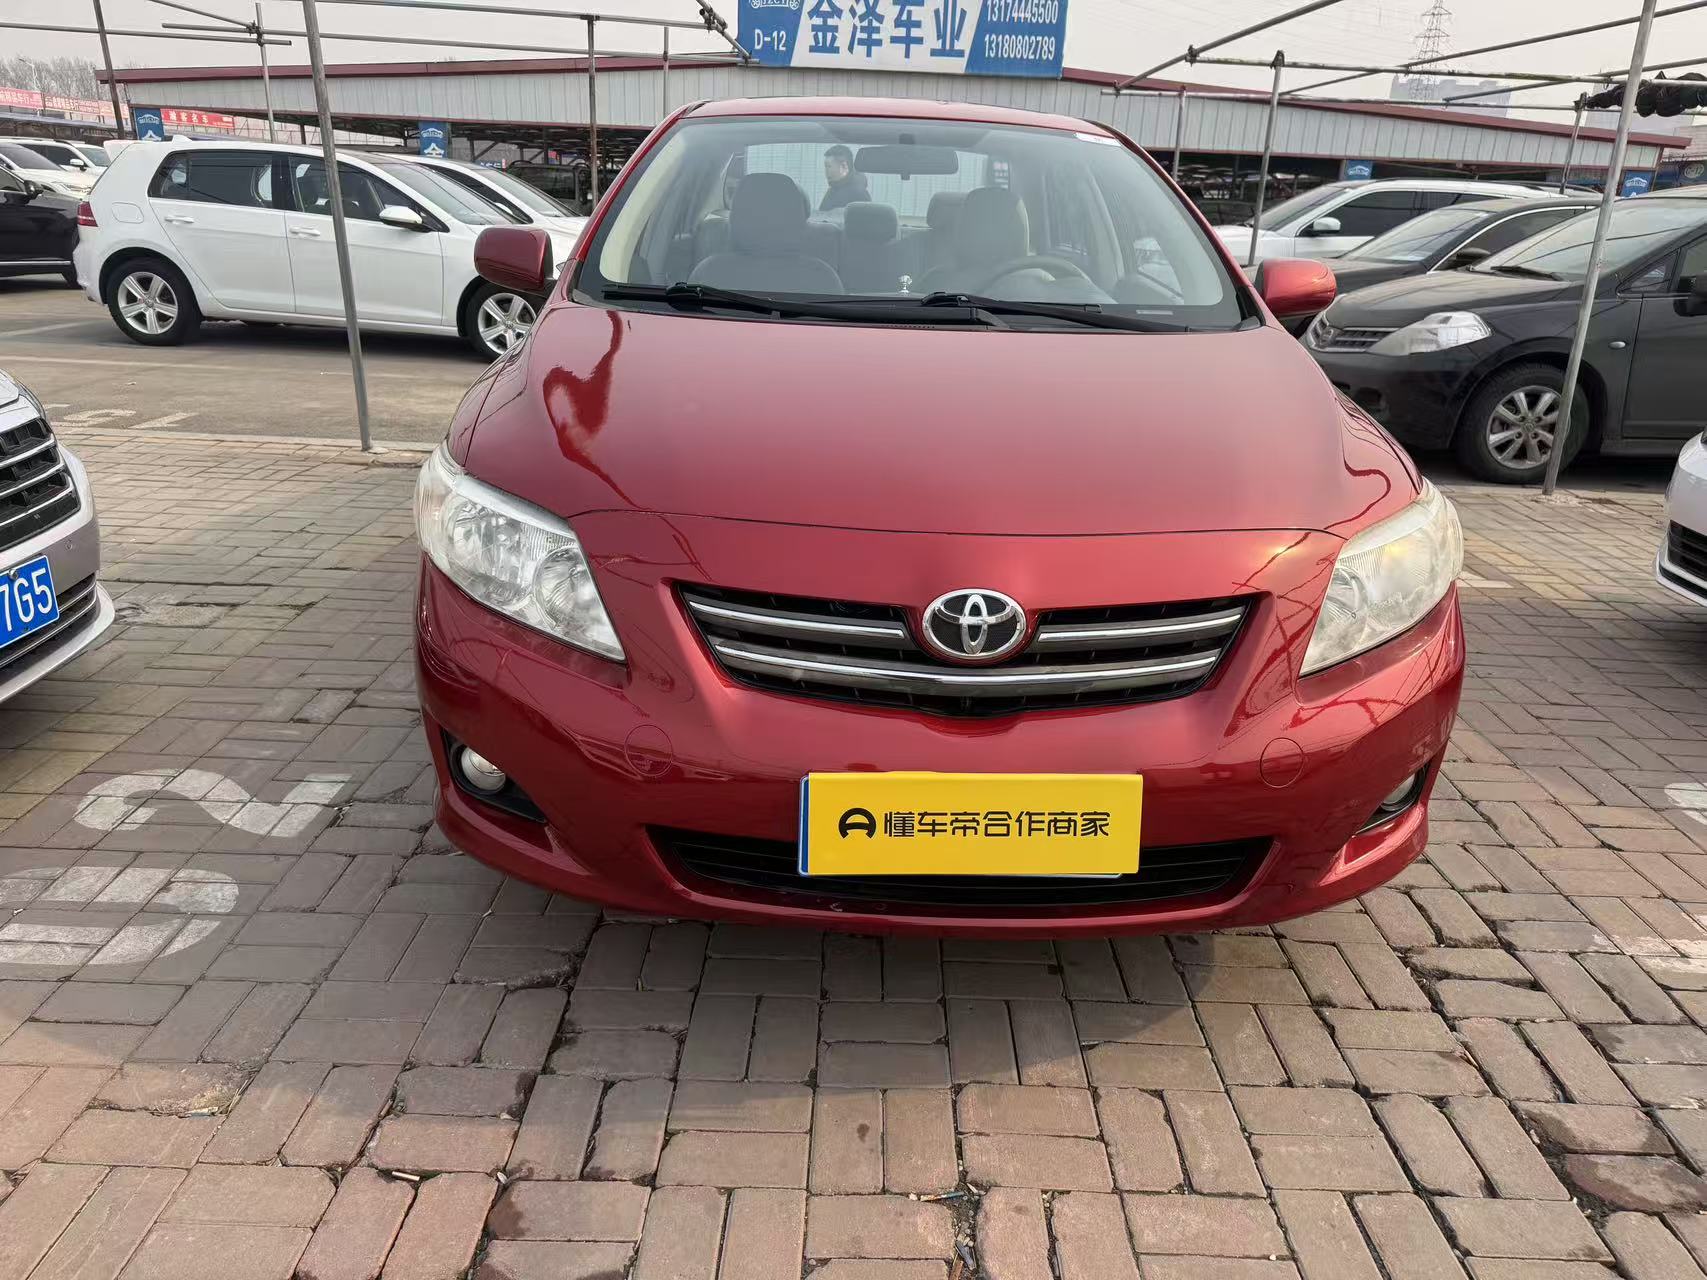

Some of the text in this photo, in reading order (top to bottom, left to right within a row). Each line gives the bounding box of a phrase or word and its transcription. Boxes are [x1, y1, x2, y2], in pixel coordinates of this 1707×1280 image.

[754, 28, 787, 51] D-12
[807, 0, 967, 58] 金泽车业
[984, 33, 1056, 61] 13180802789
[884, 810, 1111, 838] 懂车帝合作商家
